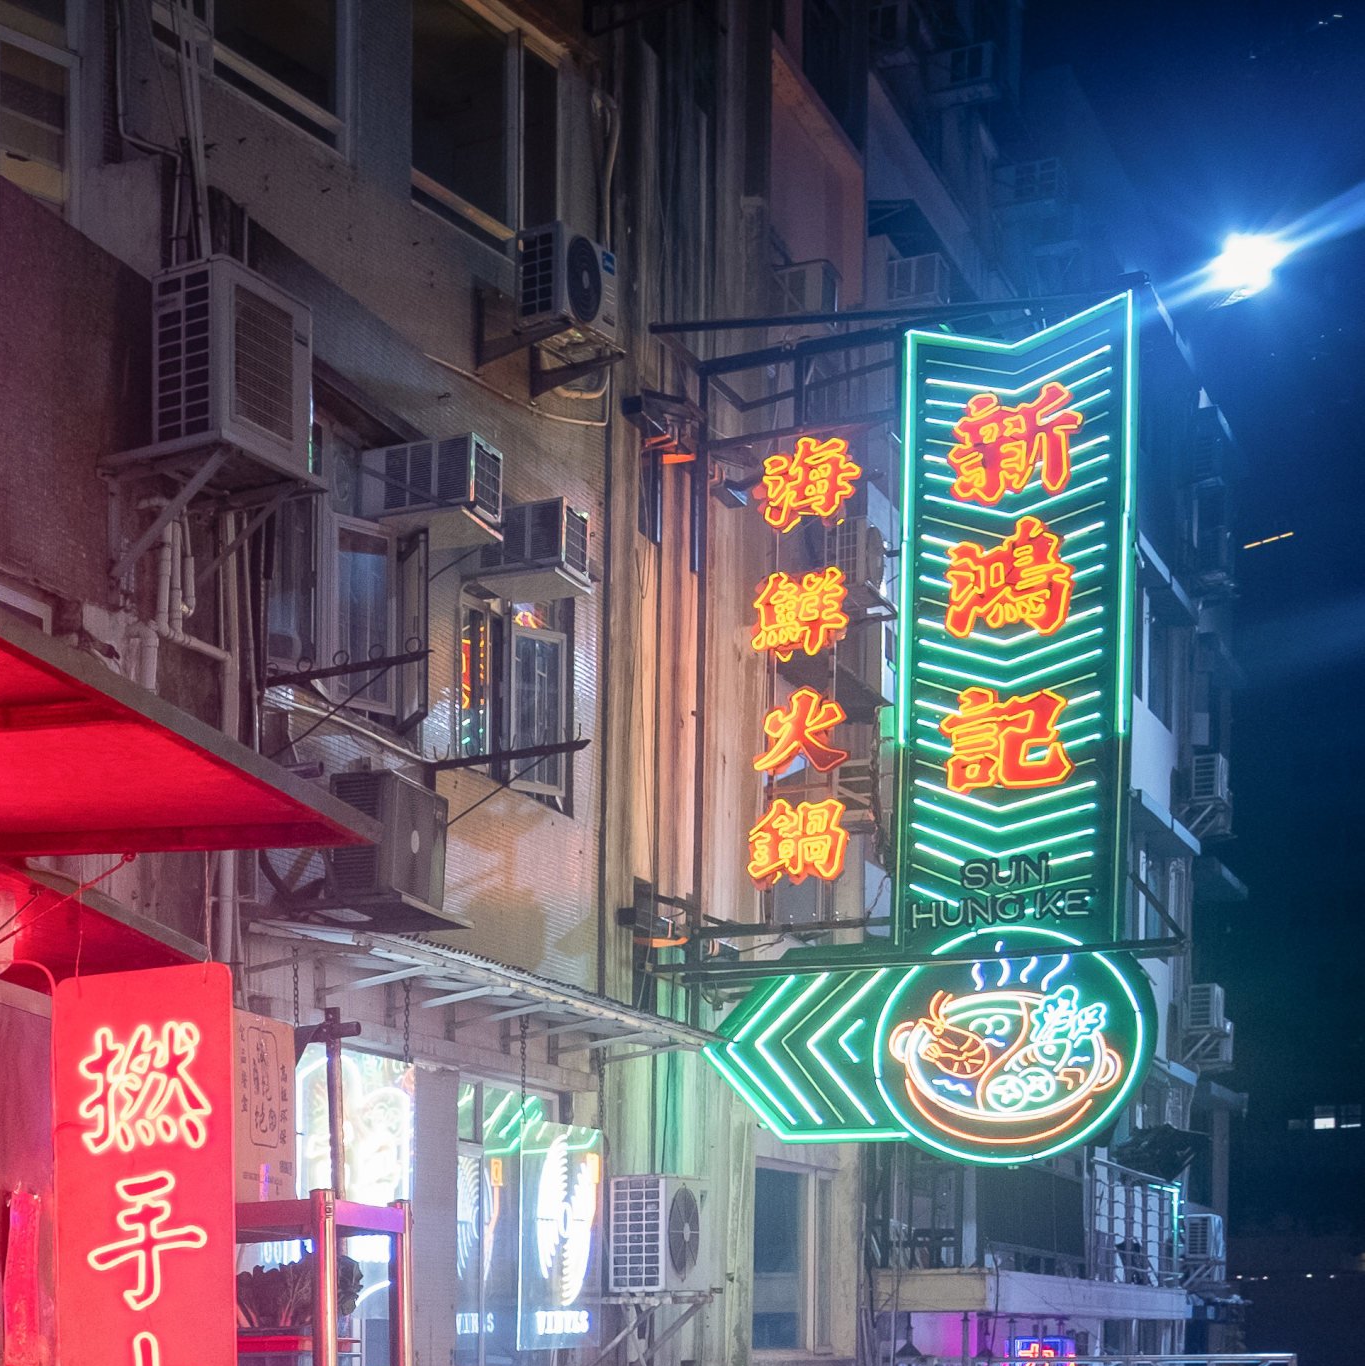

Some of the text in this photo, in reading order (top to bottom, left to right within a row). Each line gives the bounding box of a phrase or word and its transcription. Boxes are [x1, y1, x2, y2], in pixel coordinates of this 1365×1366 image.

[748, 436, 861, 885] 海鮮火鍋
[941, 382, 1083, 792] 新鴻記
[910, 887, 1092, 929] HUNG KE
[960, 853, 1052, 891] SUN
